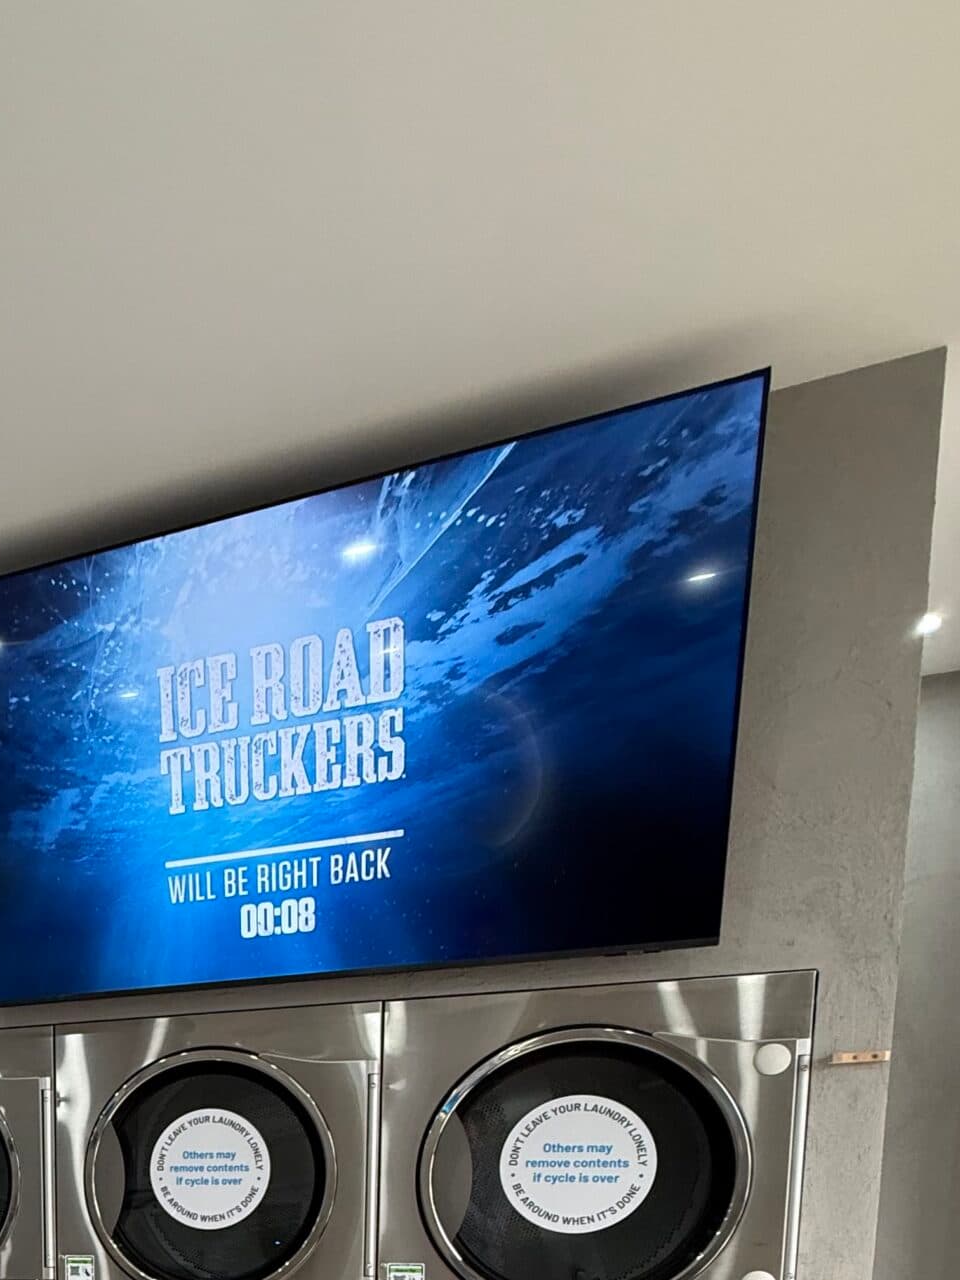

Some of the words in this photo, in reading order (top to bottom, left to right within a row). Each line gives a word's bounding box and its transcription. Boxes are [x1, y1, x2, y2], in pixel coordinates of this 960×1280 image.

[157, 652, 239, 742] ICE
[250, 616, 405, 726] ROAD
[160, 708, 404, 815] TRUCKERS
[168, 870, 216, 904] WILL
[224, 866, 248, 898] BE
[257, 857, 321, 893] RIGHT
[330, 848, 391, 884] BACK
[241, 898, 316, 938] 00:08
[157, 1147, 169, 1171] DON'T
[165, 1123, 188, 1146] LEAVE
[187, 1116, 210, 1127] YOUR
[212, 1116, 250, 1137] LAUNDRY
[247, 1137, 264, 1170] LONELY
[509, 1138, 525, 1166] DON'T
[520, 1112, 551, 1138] LEAVE
[551, 1103, 581, 1116] YOUR
[584, 1103, 633, 1129] LAUNDRY
[628, 1128, 648, 1166] LONELY
[543, 1143, 583, 1153] Others
[586, 1144, 613, 1155] may
[170, 1164, 204, 1172] remove
[206, 1164, 249, 1172] contents
[182, 1151, 214, 1159] Others
[216, 1152, 236, 1160] may
[525, 1159, 570, 1168] remove
[573, 1158, 629, 1168] contents
[176, 1177, 183, 1185] if
[185, 1177, 208, 1187] cycle
[211, 1177, 219, 1185] is
[533, 1173, 541, 1182] if
[545, 1173, 576, 1184] cycle
[579, 1173, 588, 1182] is
[592, 1175, 619, 1183] over
[161, 1186, 170, 1198] BE
[168, 1198, 199, 1220] AROUND
[200, 1214, 225, 1222] WHEN
[227, 1206, 242, 1218] IT'S
[241, 1185, 259, 1208] DONE
[513, 1183, 525, 1197] BE
[520, 1197, 559, 1223] AROUND
[562, 1216, 595, 1225] WHEN
[596, 1206, 618, 1221] IT'S
[616, 1184, 640, 1210] DONE
